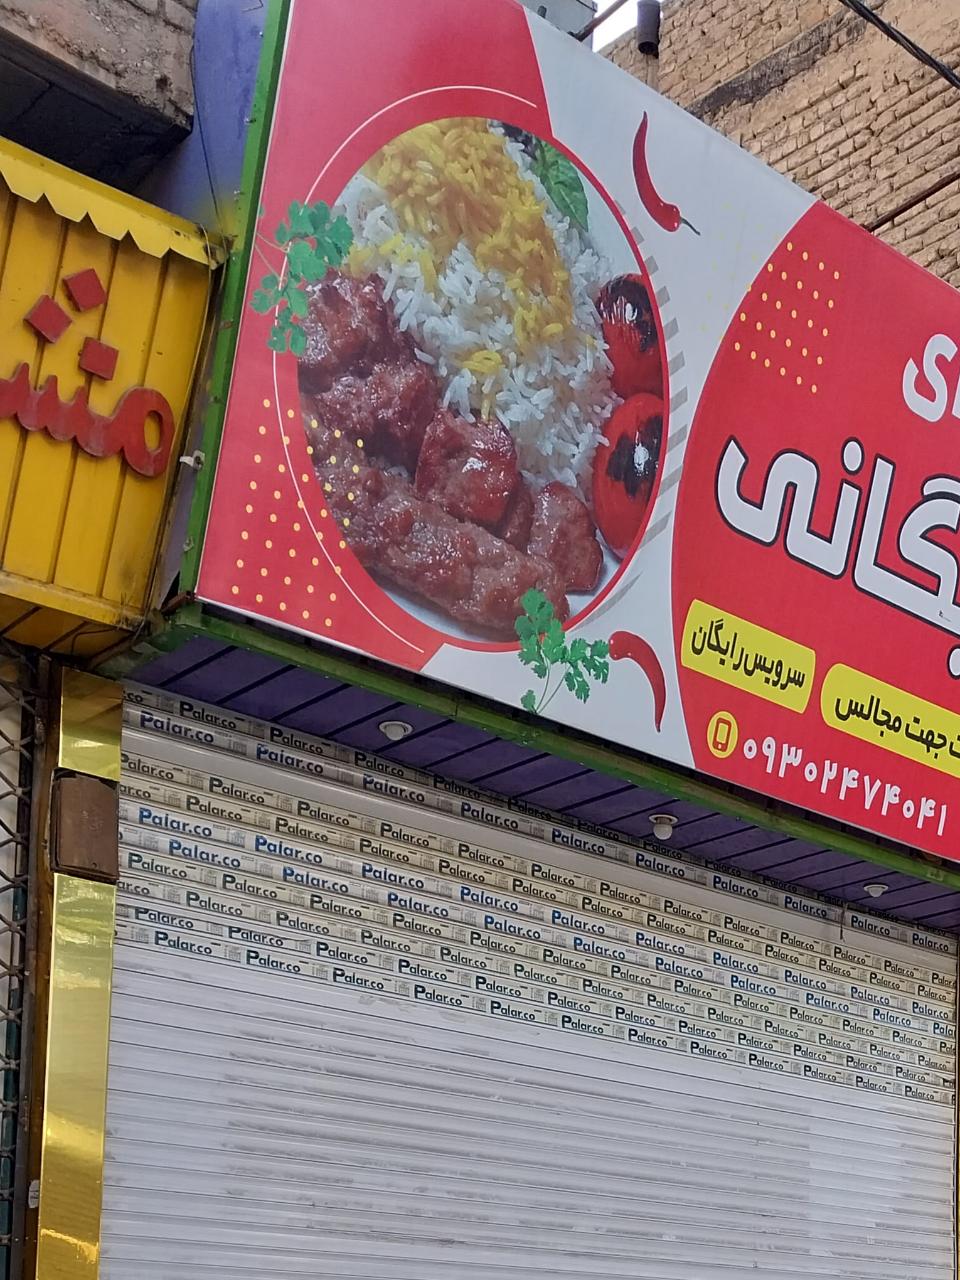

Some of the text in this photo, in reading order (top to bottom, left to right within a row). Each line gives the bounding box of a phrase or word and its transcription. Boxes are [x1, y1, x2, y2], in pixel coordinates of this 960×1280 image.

[691, 618, 806, 690] سرویس رایگان
[834, 694, 901, 738] مجالس
[179, 701, 236, 729] Palar.co
[270, 727, 322, 754] Palar.co
[354, 751, 404, 778] Palar.co
[743, 736, 947, 836] ۰۹۳۰۲۴۷۴۰۴۱
[904, 717, 947, 759] جهت
[169, 839, 241, 869] Palar.co
[283, 868, 349, 894] Palar.co
[388, 892, 448, 917] Palar.co
[484, 915, 541, 940] Palar.co
[574, 937, 626, 960] Palar.co
[656, 957, 703, 979] Palar.co
[731, 974, 776, 996] Palar.co
[806, 993, 849, 1012] Palar.co
[873, 1009, 911, 1026] Palar.co
[186, 795, 242, 821] Palar.co
[276, 818, 328, 843] Palar.co
[360, 838, 409, 864] Palar.co
[439, 859, 486, 883] Palar.co
[512, 878, 557, 901] Palar.co
[582, 896, 623, 918] Palar.co
[647, 914, 686, 934] Palar.co
[708, 930, 744, 950] Palar.co
[765, 946, 799, 963] Palar.co
[819, 959, 851, 977] Palar.co
[870, 973, 900, 989] Palar.co
[918, 985, 946, 1001] Palar.co
[209, 776, 264, 804] Palar.co
[298, 801, 350, 825] Palar.co
[381, 822, 430, 846] Palar.co
[459, 843, 504, 867] Palar.co
[532, 864, 575, 886] Palar.co
[600, 882, 641, 904] Palar.co
[664, 900, 702, 921] Palar.co
[724, 916, 760, 936] Palar.co
[781, 932, 814, 950] Palar.co
[834, 946, 865, 964] Palar.co
[884, 960, 914, 977] Palar.co
[461, 802, 518, 830] Palar.co
[552, 828, 604, 854] Palar.co
[636, 853, 685, 878] Palar.co
[713, 876, 758, 898] Palar.co
[785, 896, 827, 918] Palar.co
[851, 915, 890, 936] Palar.co
[913, 933, 948, 951] Palar.co
[127, 853, 187, 879] Palar.co
[222, 875, 277, 899] Palar.co
[310, 894, 362, 918] Palar.co
[392, 914, 441, 936] Palar.co
[470, 931, 516, 954] Palar.co
[543, 948, 586, 969] Palar.co
[611, 965, 651, 985] Palar.co
[674, 980, 712, 999] Palar.co
[734, 994, 769, 1012] Palar.co
[790, 1007, 824, 1025] Palar.co
[842, 1020, 874, 1037] Palar.co
[892, 1032, 923, 1047] Palar.co
[155, 931, 935, 1100] Palar.co Palar.co Palar.co Palar.co Palar.co Palar.co Palar.co Palar.co Palar.co Palar.co Palar.co Palar.co
[186, 891, 242, 916] Palar.co
[276, 912, 330, 935] Palar.co
[361, 930, 411, 953] Palar.co
[440, 947, 488, 969] Palar.co
[514, 963, 557, 985] Palar.co
[583, 979, 624, 1000] Palar.co
[647, 994, 686, 1014] Palar.co
[708, 1008, 744, 1026] Palar.co
[764, 1021, 799, 1039] Palar.co
[818, 1033, 851, 1050] Palar.co
[870, 1044, 900, 1060] Palar.co
[918, 1055, 947, 1070] Palar.co
[316, 941, 368, 965] Palar.co
[398, 959, 447, 982] Palar.co
[476, 975, 521, 998] Palar.co
[548, 991, 590, 1012] Palar.co
[615, 1007, 656, 1026] Palar.co
[679, 1020, 716, 1039] Palar.co
[738, 1032, 773, 1050] Palar.co
[794, 1044, 826, 1061] Palar.co
[846, 1055, 877, 1072] Palar.co
[896, 1067, 926, 1082] Palar.co
[460, 887, 518, 912] Palar.co
[552, 911, 604, 935] Palar.co
[636, 932, 685, 955] Palar.co
[713, 952, 758, 973] Palar.co
[785, 970, 826, 990] Palar.co
[851, 987, 889, 1004] Palar.co
[913, 1002, 948, 1019] Palar.co
